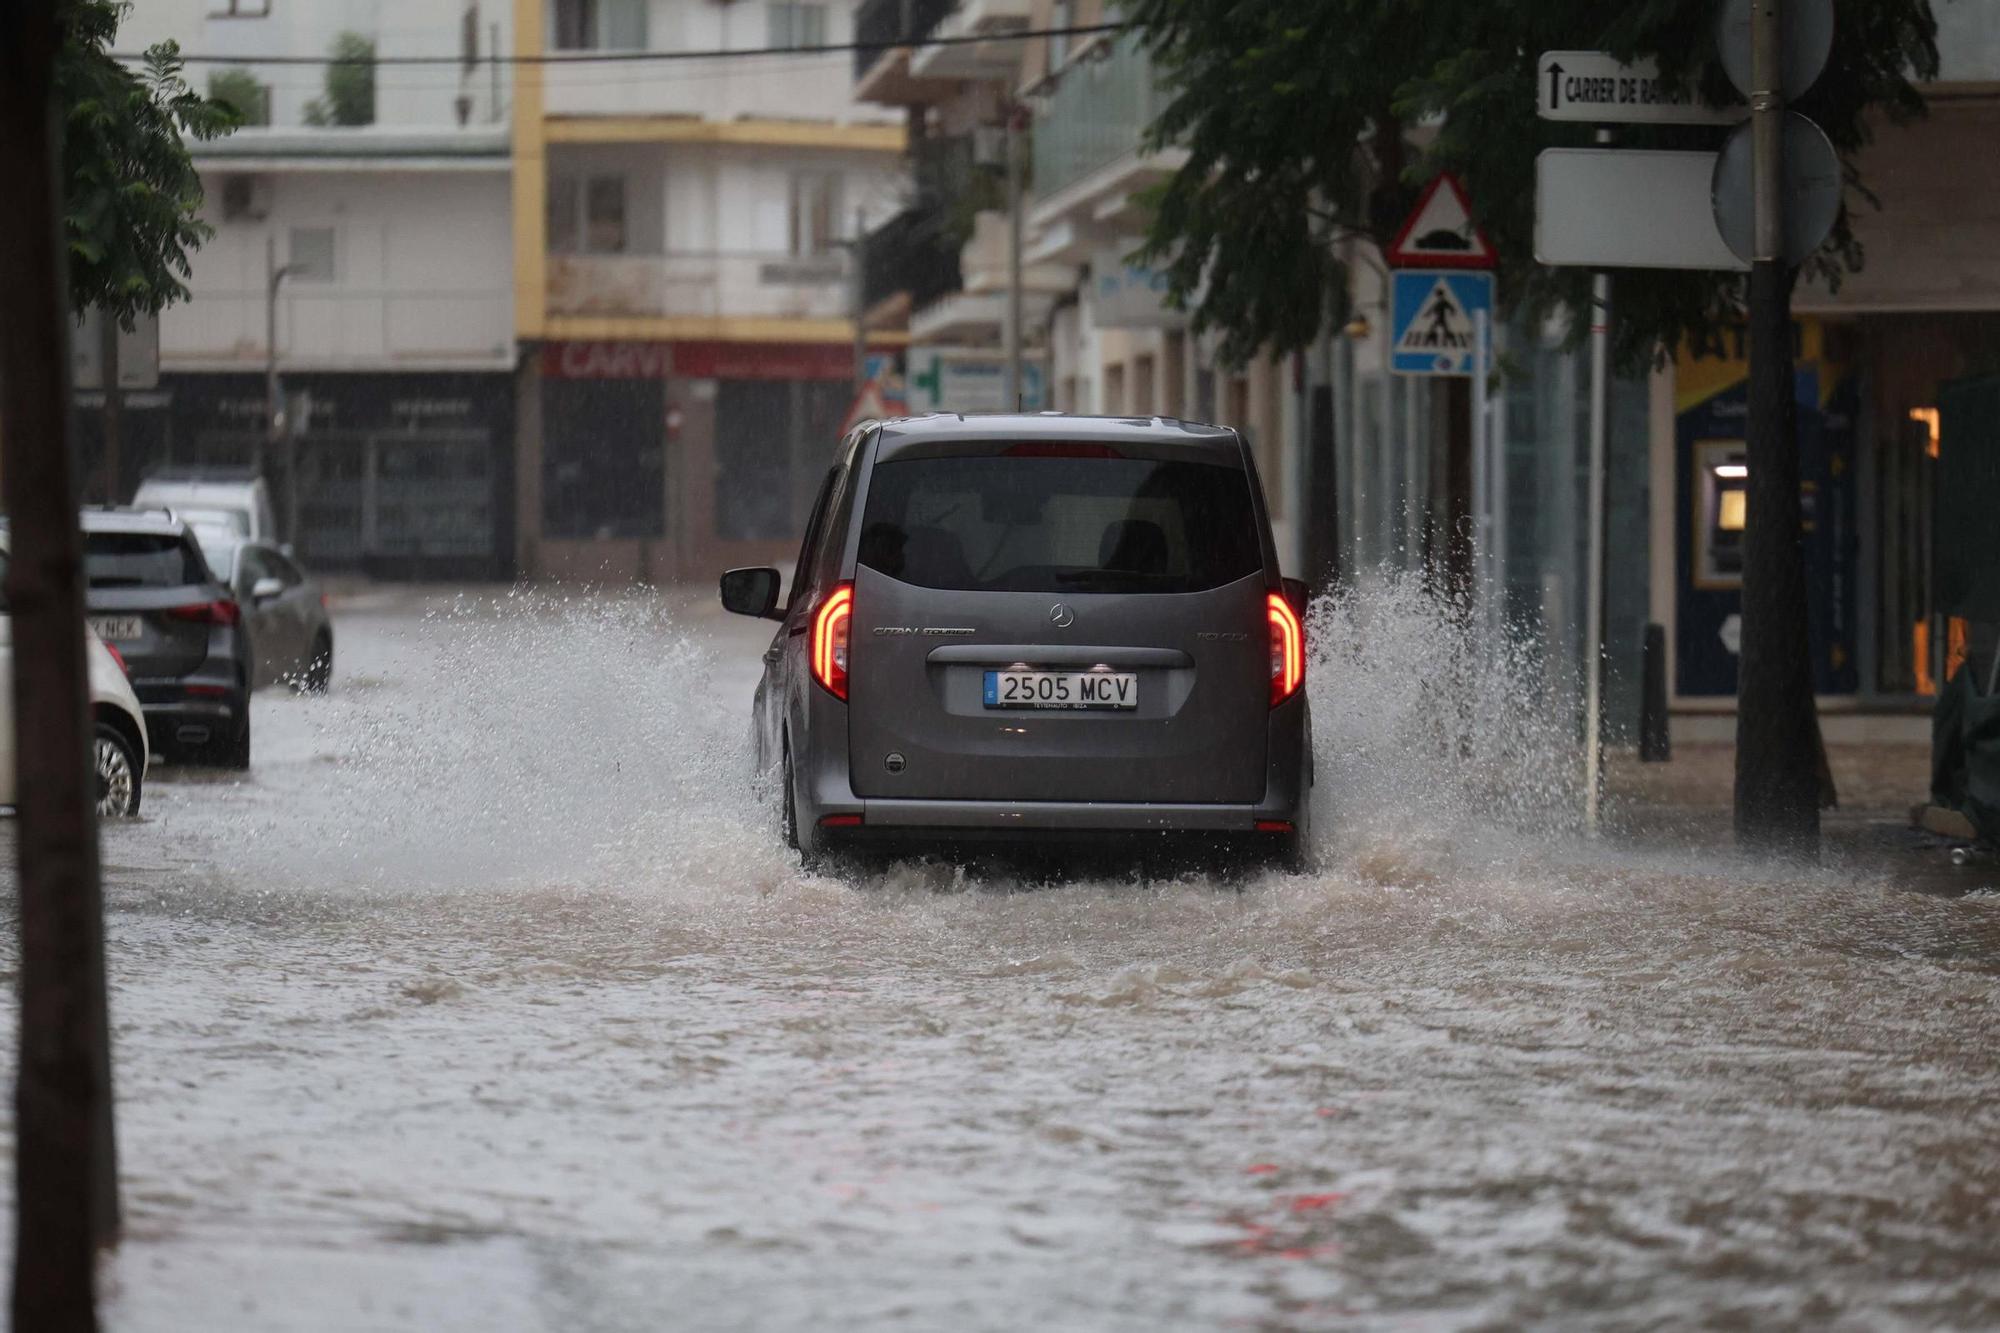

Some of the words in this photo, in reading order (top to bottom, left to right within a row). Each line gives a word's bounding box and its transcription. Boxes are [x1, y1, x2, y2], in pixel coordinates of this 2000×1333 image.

[1565, 76, 1615, 103] CARRER
[1619, 77, 1637, 104] DE
[561, 343, 673, 378] CARVI
[987, 690, 994, 698] E
[1003, 677, 1070, 701] 2505
[1080, 677, 1129, 702] MCV
